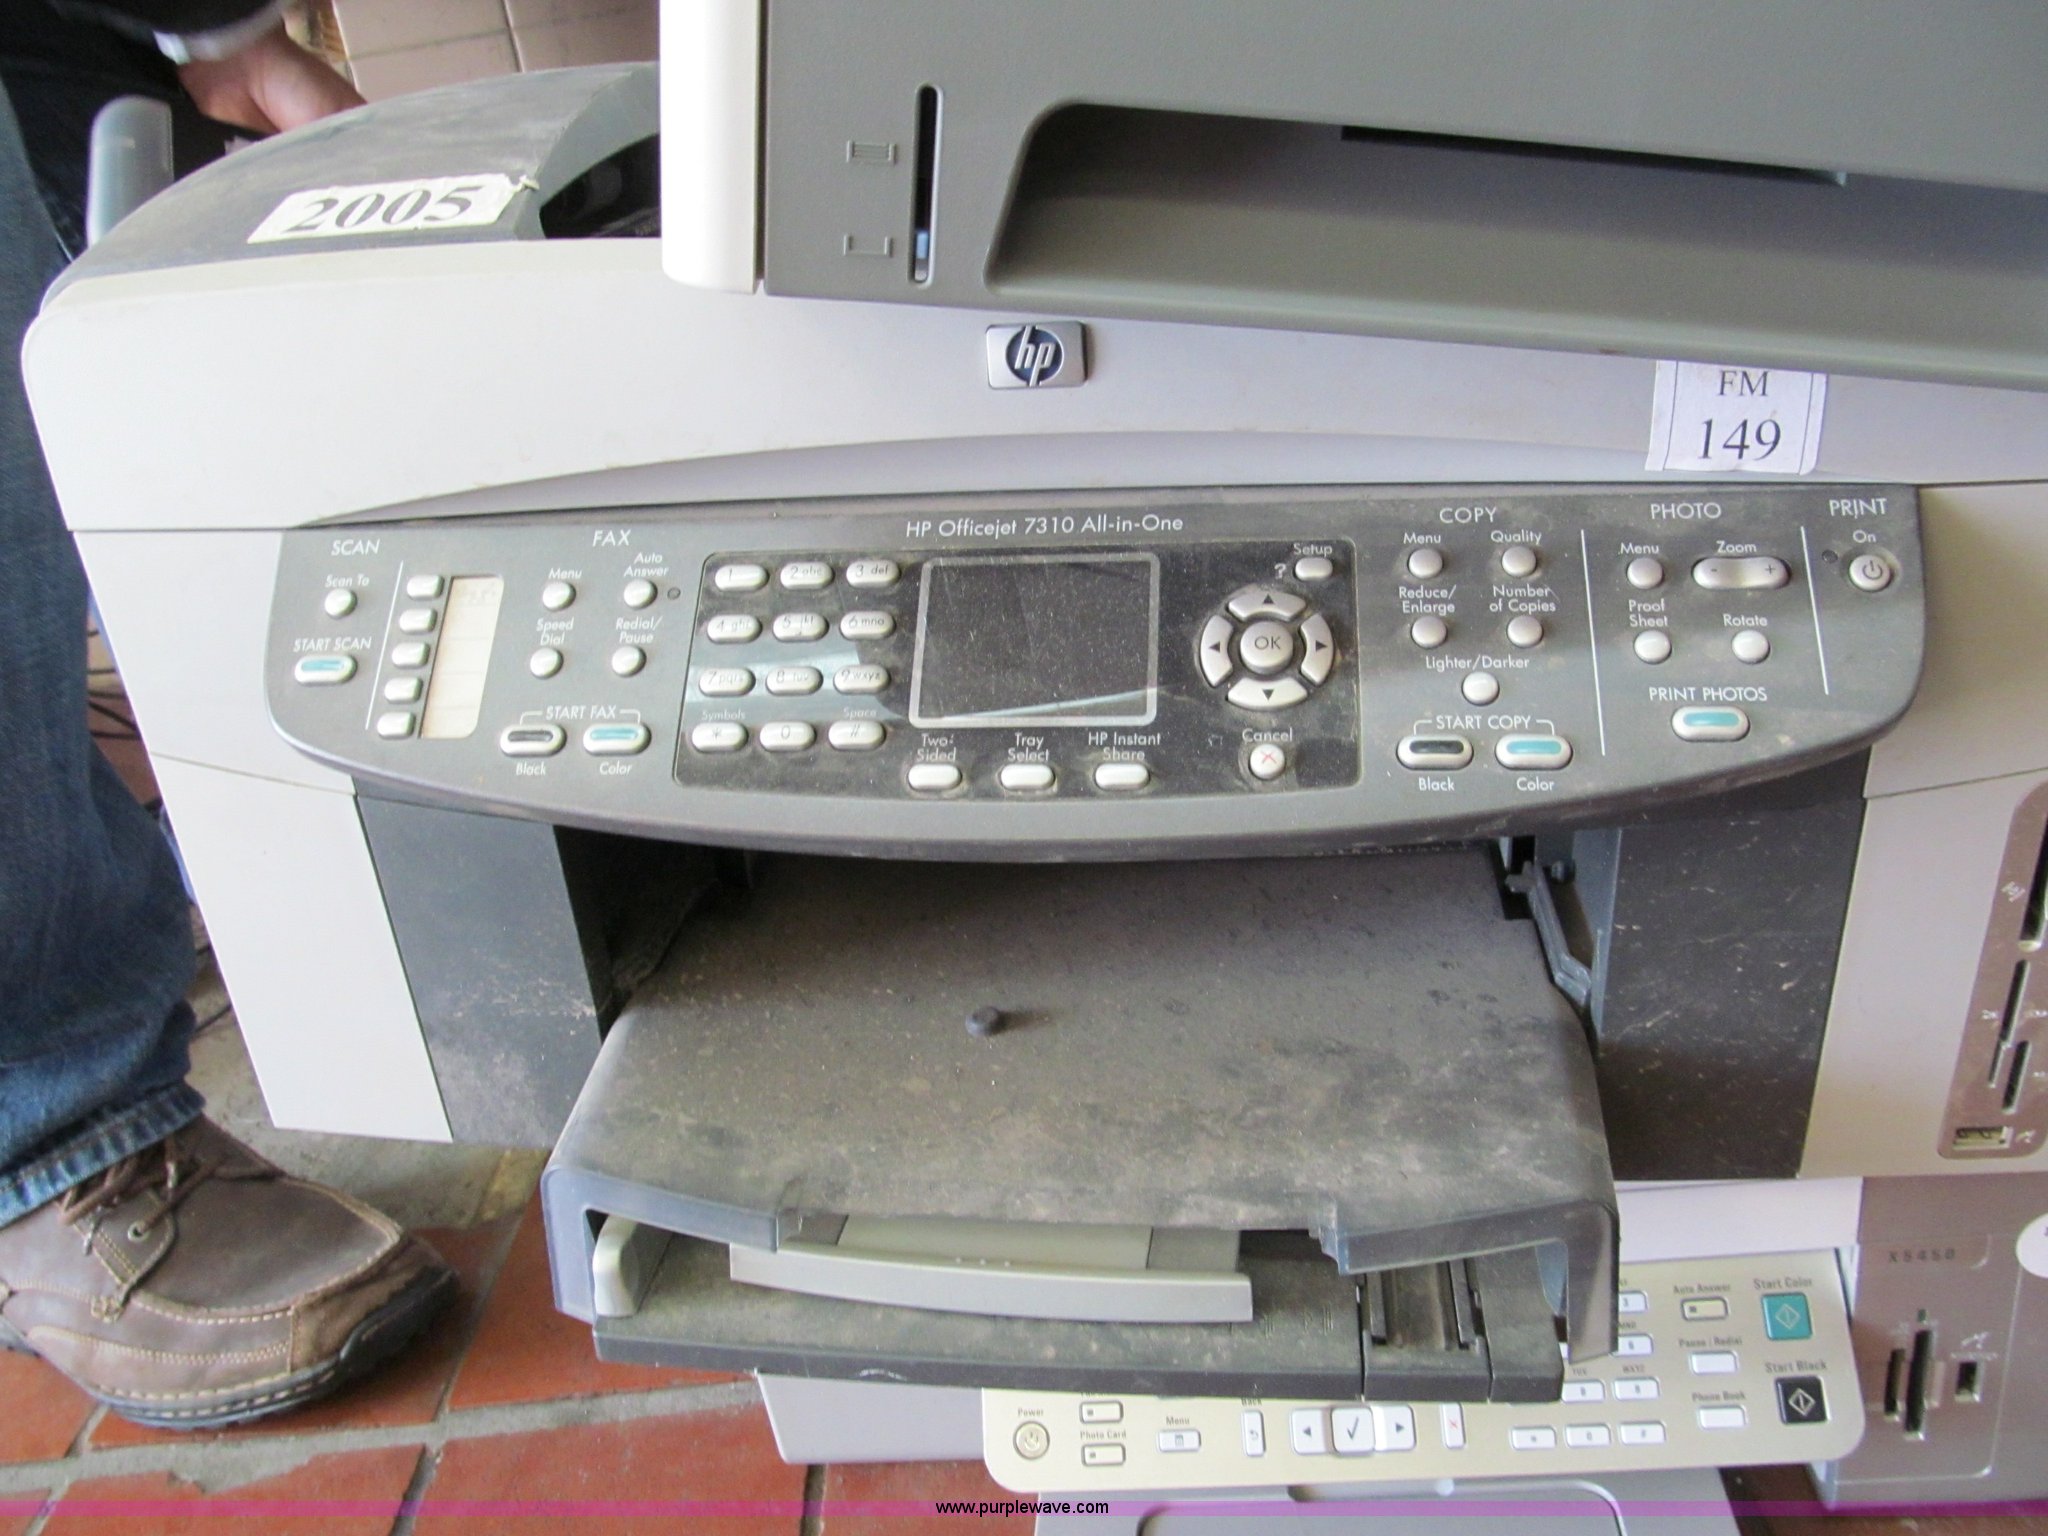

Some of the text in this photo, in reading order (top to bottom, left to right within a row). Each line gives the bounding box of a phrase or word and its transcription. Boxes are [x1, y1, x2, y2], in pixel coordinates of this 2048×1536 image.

[282, 186, 484, 233] 2005
[1015, 325, 1056, 387] hp
[1717, 370, 1769, 396] FM
[1698, 418, 1781, 460] 149
[1651, 503, 1721, 519] PHOTO
[1829, 498, 1887, 517] PRINT
[1440, 507, 1497, 523] COPY
[906, 515, 1183, 539] HP Officejet 7310 All-in-One
[592, 530, 631, 546] FAX
[1404, 532, 1441, 544] Menu
[1491, 530, 1541, 544] Quality
[1853, 531, 1876, 543] On
[331, 540, 380, 556] SCAN
[1293, 544, 1332, 558] Setup
[1620, 543, 1659, 554] Menu
[1716, 541, 1757, 553] Zoom
[634, 552, 662, 564] Auto
[549, 568, 582, 580] Menu
[624, 565, 668, 577] Answer
[790, 566, 799, 580] 2
[856, 565, 889, 577] 3 def
[1274, 564, 1286, 579] ?
[325, 575, 369, 587] Scan To
[1399, 586, 1456, 599] Reduce/
[1493, 586, 1549, 598] Number
[1402, 601, 1455, 616] Enlarge
[1489, 600, 1556, 614] of Copies
[1629, 599, 1665, 612] Proof
[536, 618, 574, 632] Speed
[615, 617, 662, 631] Redial/
[782, 617, 791, 628] 5
[850, 617, 884, 628] 6 mno
[1629, 615, 1667, 627] Sheet
[1723, 615, 1767, 626] Rotate
[540, 631, 565, 644] Dial
[619, 631, 654, 644] Pause
[1254, 635, 1281, 651] OK
[294, 637, 371, 652] START SCAN
[1426, 655, 1529, 672] Lighter/Darker
[708, 671, 717, 682] 7
[776, 671, 784, 683] 8
[842, 671, 880, 682] 9 wxyz
[1649, 687, 1767, 701] PRINT PHOTOS
[546, 706, 616, 719] START FAX
[702, 710, 745, 721] Symbols
[843, 708, 876, 718] Space
[1436, 716, 1531, 729] START COPY
[781, 727, 790, 739] 0
[1088, 732, 1160, 746] HP Instant
[1242, 728, 1292, 742] Cancel
[1015, 732, 1044, 748] Tray
[916, 747, 956, 762] Sided
[1007, 748, 1050, 762] Select
[1103, 747, 1145, 761] Share
[516, 762, 546, 776] Black
[599, 762, 632, 775] Color
[1419, 778, 1454, 791] Black
[1516, 777, 1554, 791] Color
[1674, 1282, 1730, 1294] Auto Answer
[1754, 1277, 1813, 1290] Start Color
[1679, 1338, 1707, 1348] Pause
[1714, 1337, 1742, 1347] Redial
[1765, 1360, 1827, 1373] Start Black
[1692, 1391, 1745, 1402] Phone Book
[1018, 1409, 1044, 1417] Power
[1166, 1417, 1190, 1425] Menu
[1080, 1431, 1127, 1440] Photo Card
